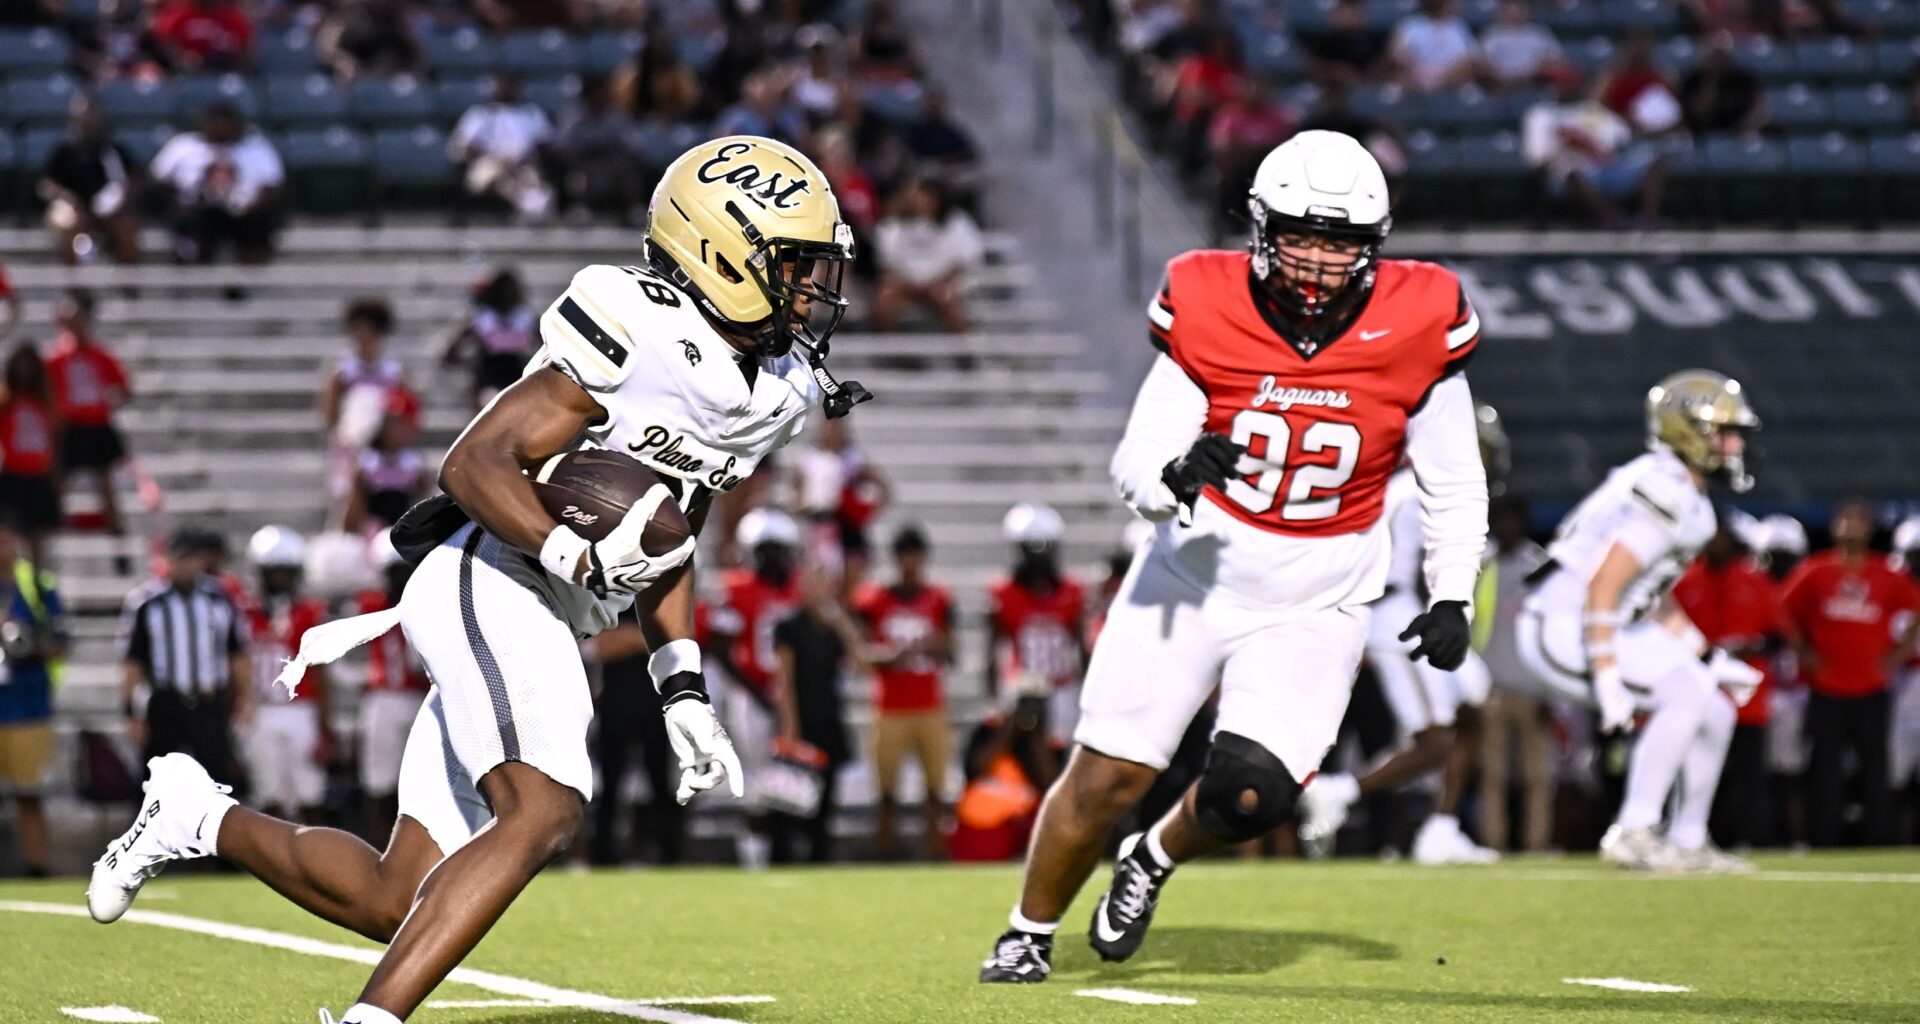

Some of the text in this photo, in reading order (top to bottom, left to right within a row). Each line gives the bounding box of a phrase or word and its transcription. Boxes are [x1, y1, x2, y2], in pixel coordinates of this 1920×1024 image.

[696, 142, 811, 209] East
[1251, 374, 1352, 411] Jaguars
[627, 425, 704, 473] Plano
[708, 455, 745, 492] Ea
[1224, 408, 1362, 521] 92
